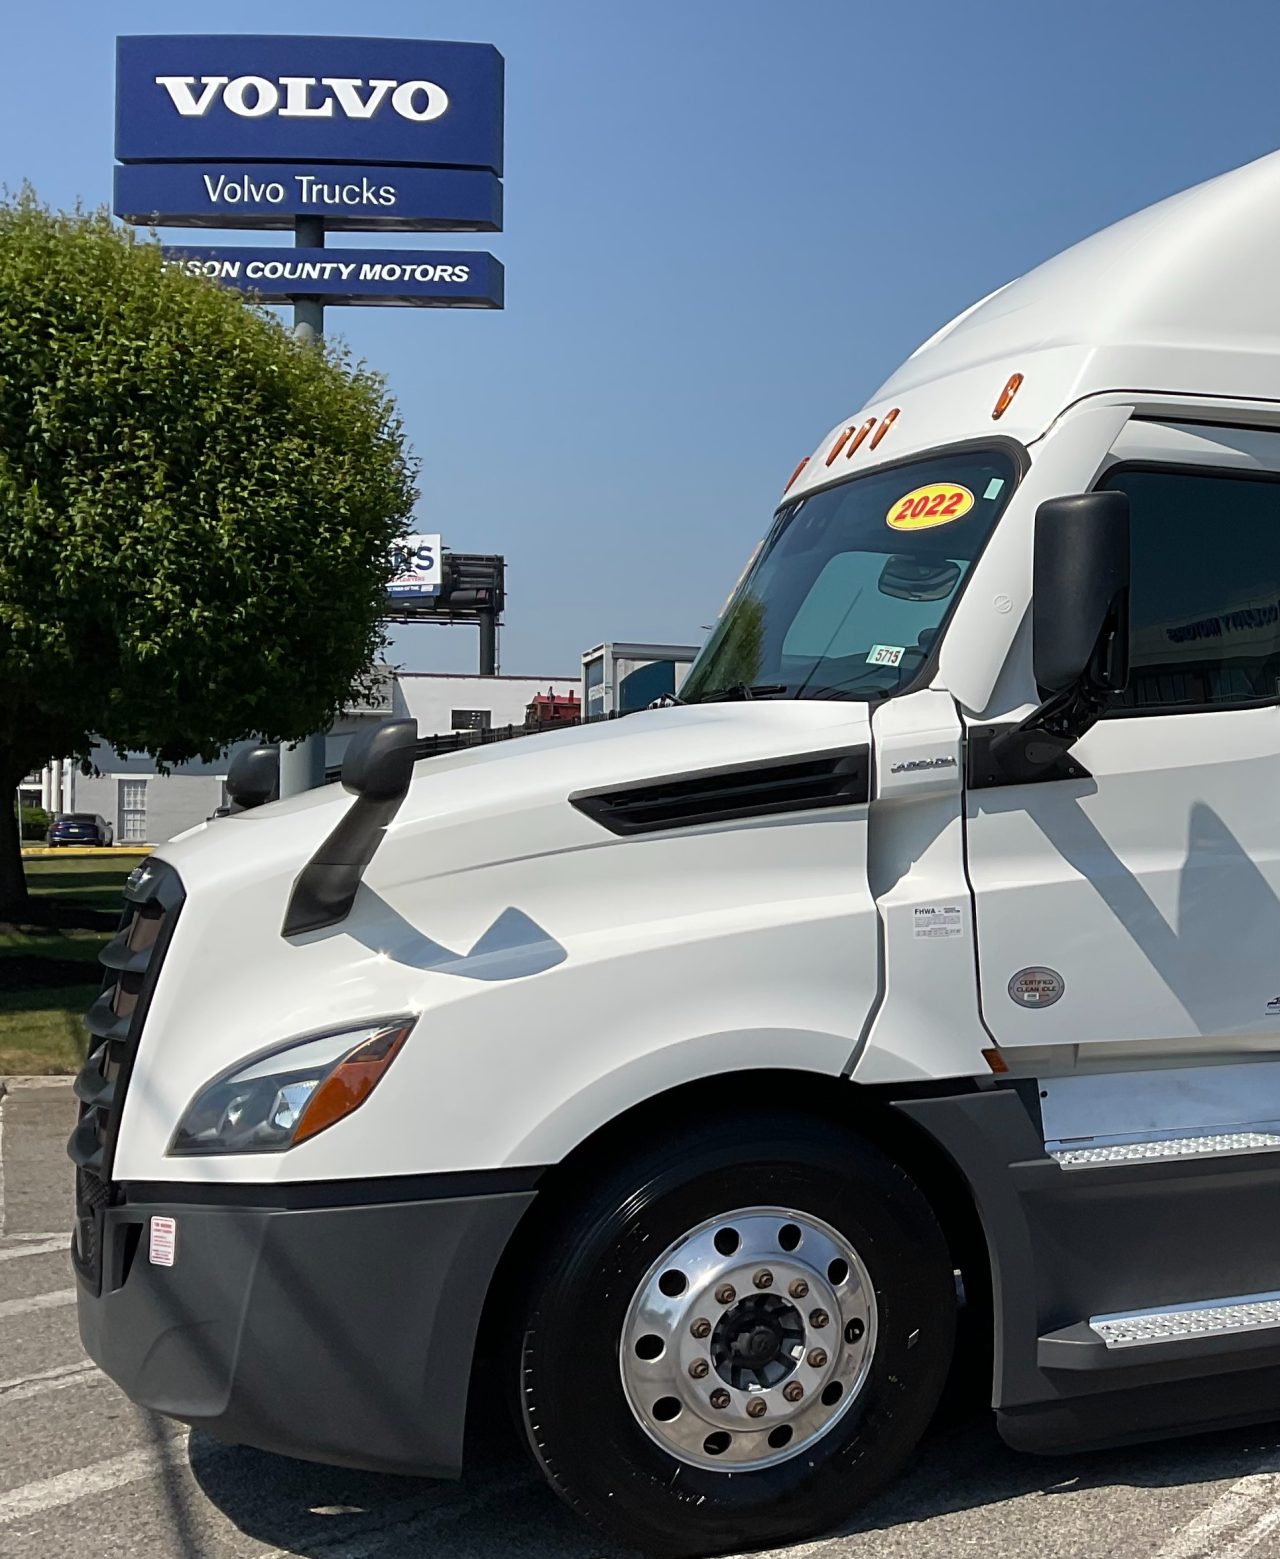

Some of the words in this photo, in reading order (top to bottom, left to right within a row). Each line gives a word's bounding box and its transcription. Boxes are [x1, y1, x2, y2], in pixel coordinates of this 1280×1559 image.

[155, 75, 448, 121] VOLVO
[203, 174, 284, 202] Volvo
[295, 175, 396, 205] Trucks
[246, 261, 356, 279] COUNTY
[359, 264, 469, 282] MOTORS
[893, 492, 964, 522] 2022
[876, 649, 901, 664] 5715
[914, 907, 936, 915] FHWA
